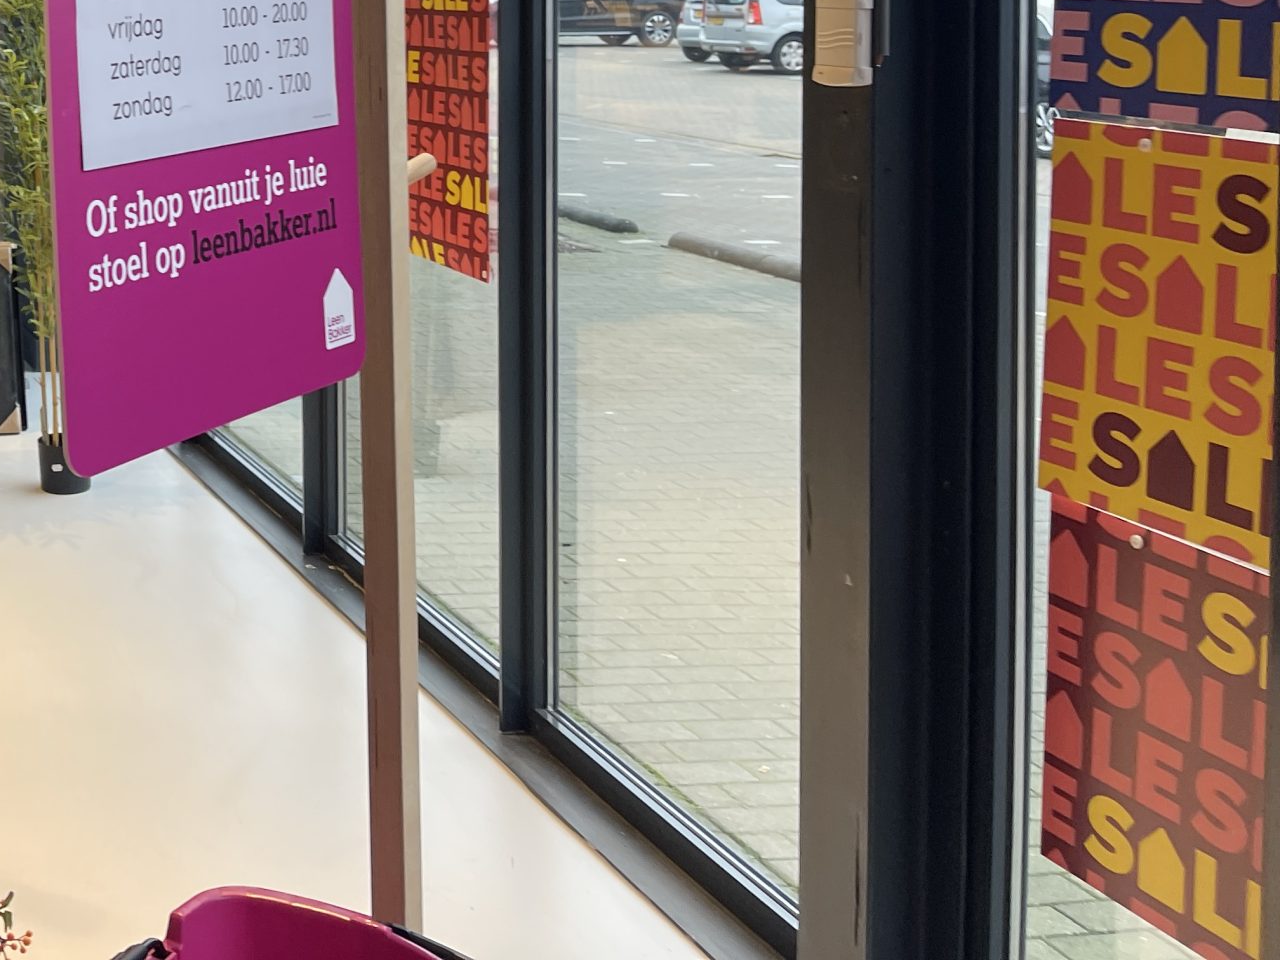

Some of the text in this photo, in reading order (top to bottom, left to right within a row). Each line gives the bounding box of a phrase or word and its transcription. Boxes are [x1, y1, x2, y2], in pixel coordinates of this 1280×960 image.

[108, 13, 164, 42] vrijdag
[222, 6, 258, 28] 10.00
[272, 1, 308, 24] 20.00
[110, 51, 182, 80] zaterdag
[223, 42, 259, 66] 10.00
[276, 36, 310, 60] 17.30
[113, 92, 173, 120] zondag
[226, 78, 263, 103] 12.00
[279, 72, 312, 95] 17.00
[86, 156, 327, 238] Of shop vanuit je luie
[88, 197, 338, 293] stoel op leenbakker.nl
